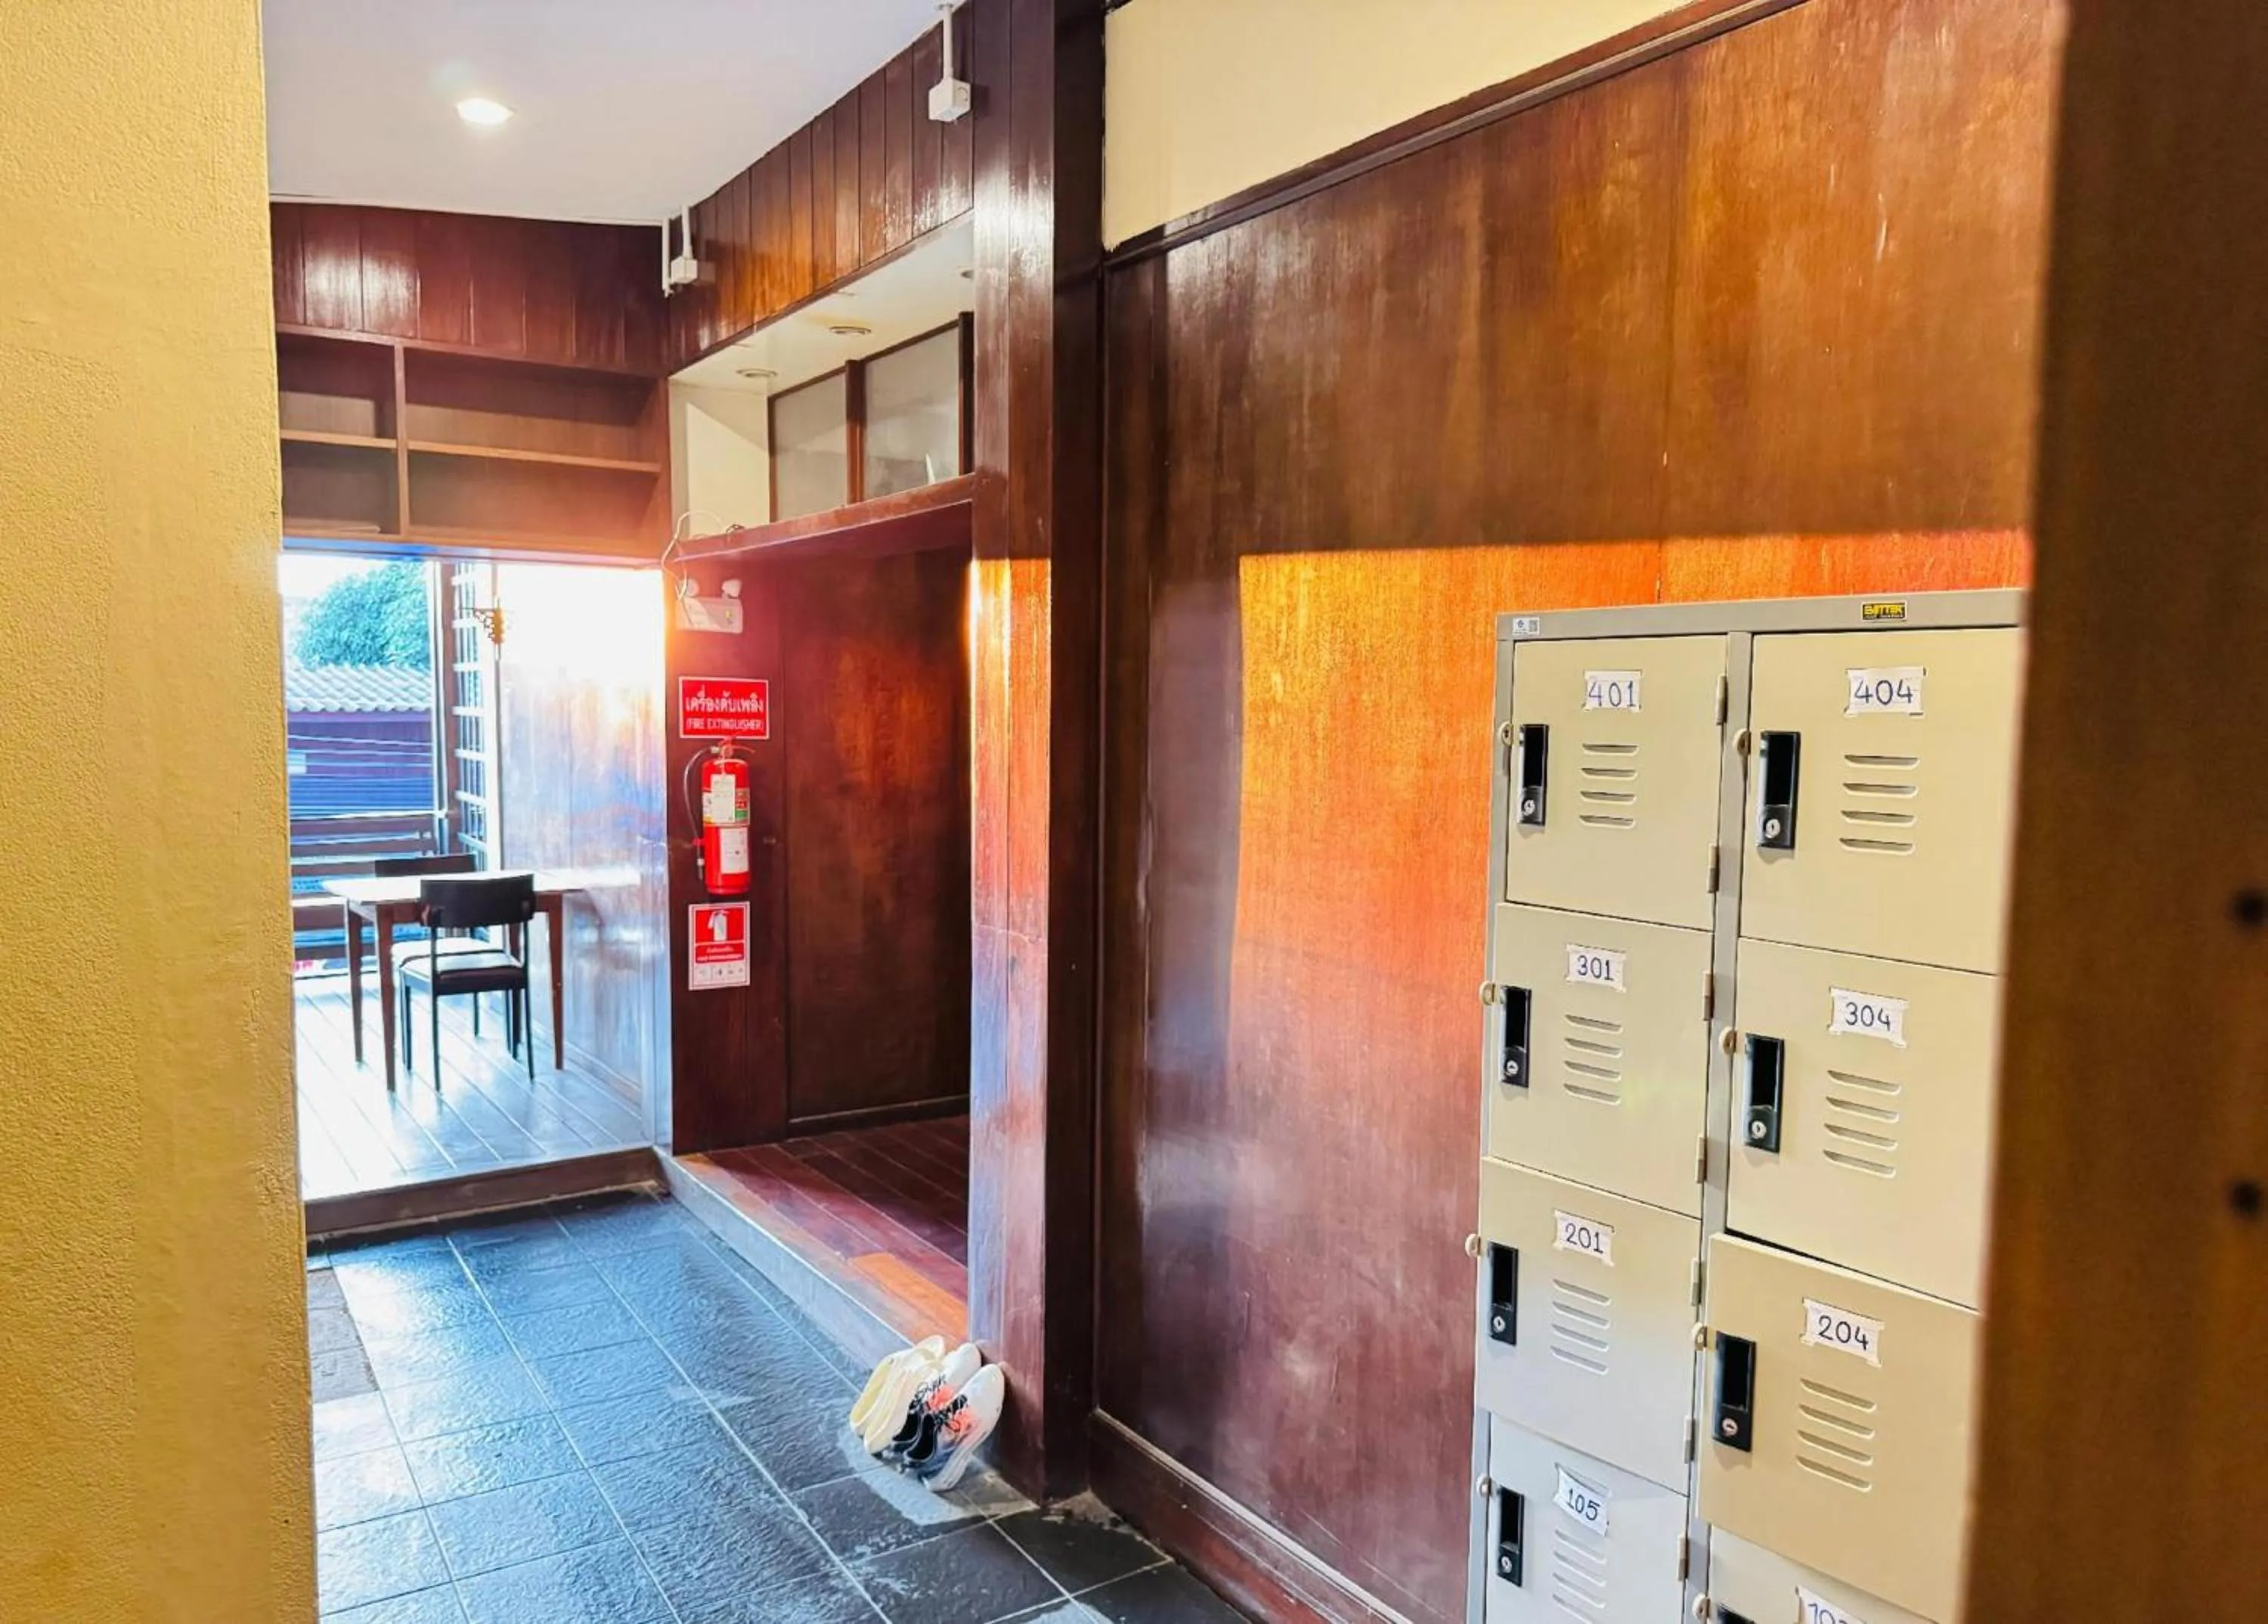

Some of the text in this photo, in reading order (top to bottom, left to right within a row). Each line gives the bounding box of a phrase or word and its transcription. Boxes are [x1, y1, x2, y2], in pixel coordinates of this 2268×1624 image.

[1588, 680, 1637, 708] 401
[1854, 678, 1913, 706] 404
[1577, 954, 1614, 981] 301
[1845, 1001, 1891, 1032] 304
[1565, 1223, 1603, 1254] 201
[1817, 1315, 1870, 1351] 204
[1567, 1488, 1600, 1521] 105
[1808, 1603, 1849, 1624] 10
